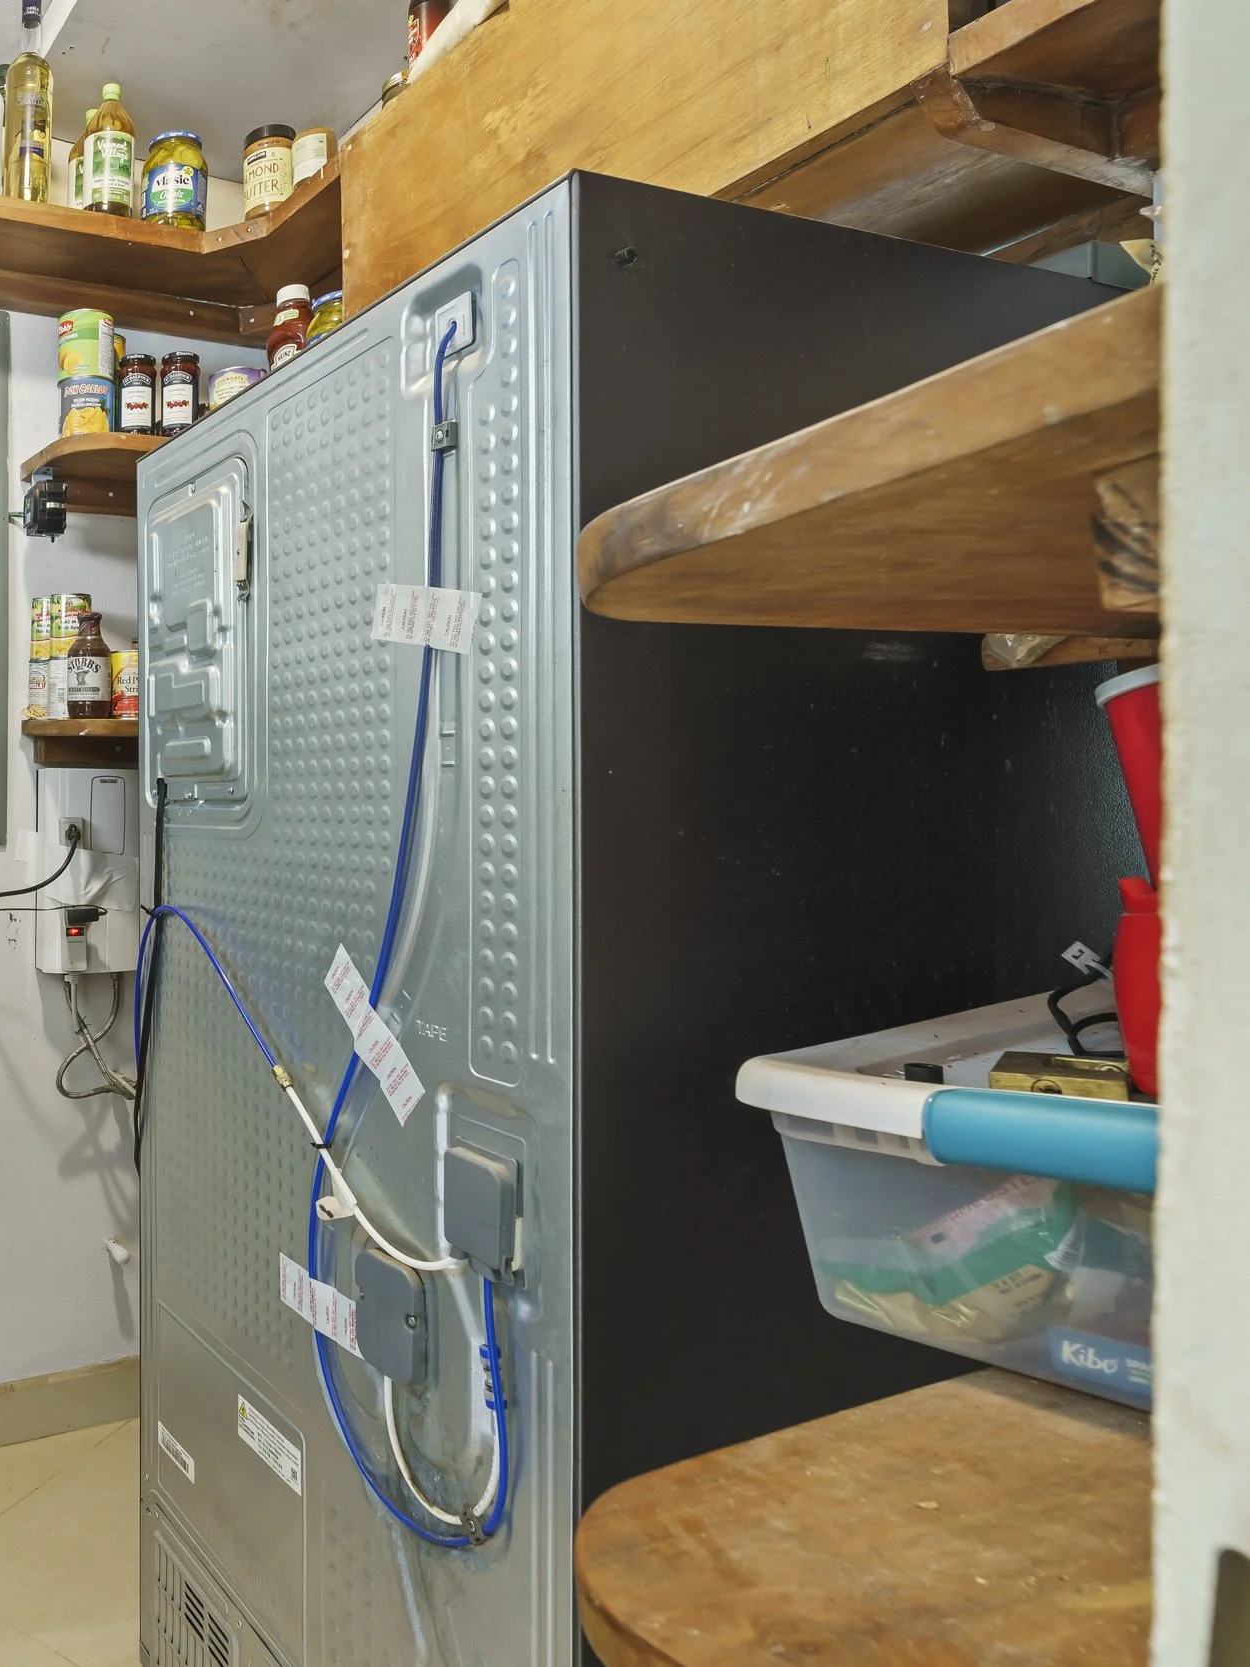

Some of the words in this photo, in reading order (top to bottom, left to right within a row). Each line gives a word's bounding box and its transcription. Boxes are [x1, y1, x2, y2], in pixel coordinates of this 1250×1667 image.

[245, 162, 279, 183] LMOND
[246, 179, 280, 200] UTTER
[277, 349, 292, 361] HEINZ
[68, 657, 101, 673] STUBB'S
[117, 676, 131, 685] Red
[416, 1019, 447, 1043] TAPE
[1062, 1340, 1118, 1374] Kibo
